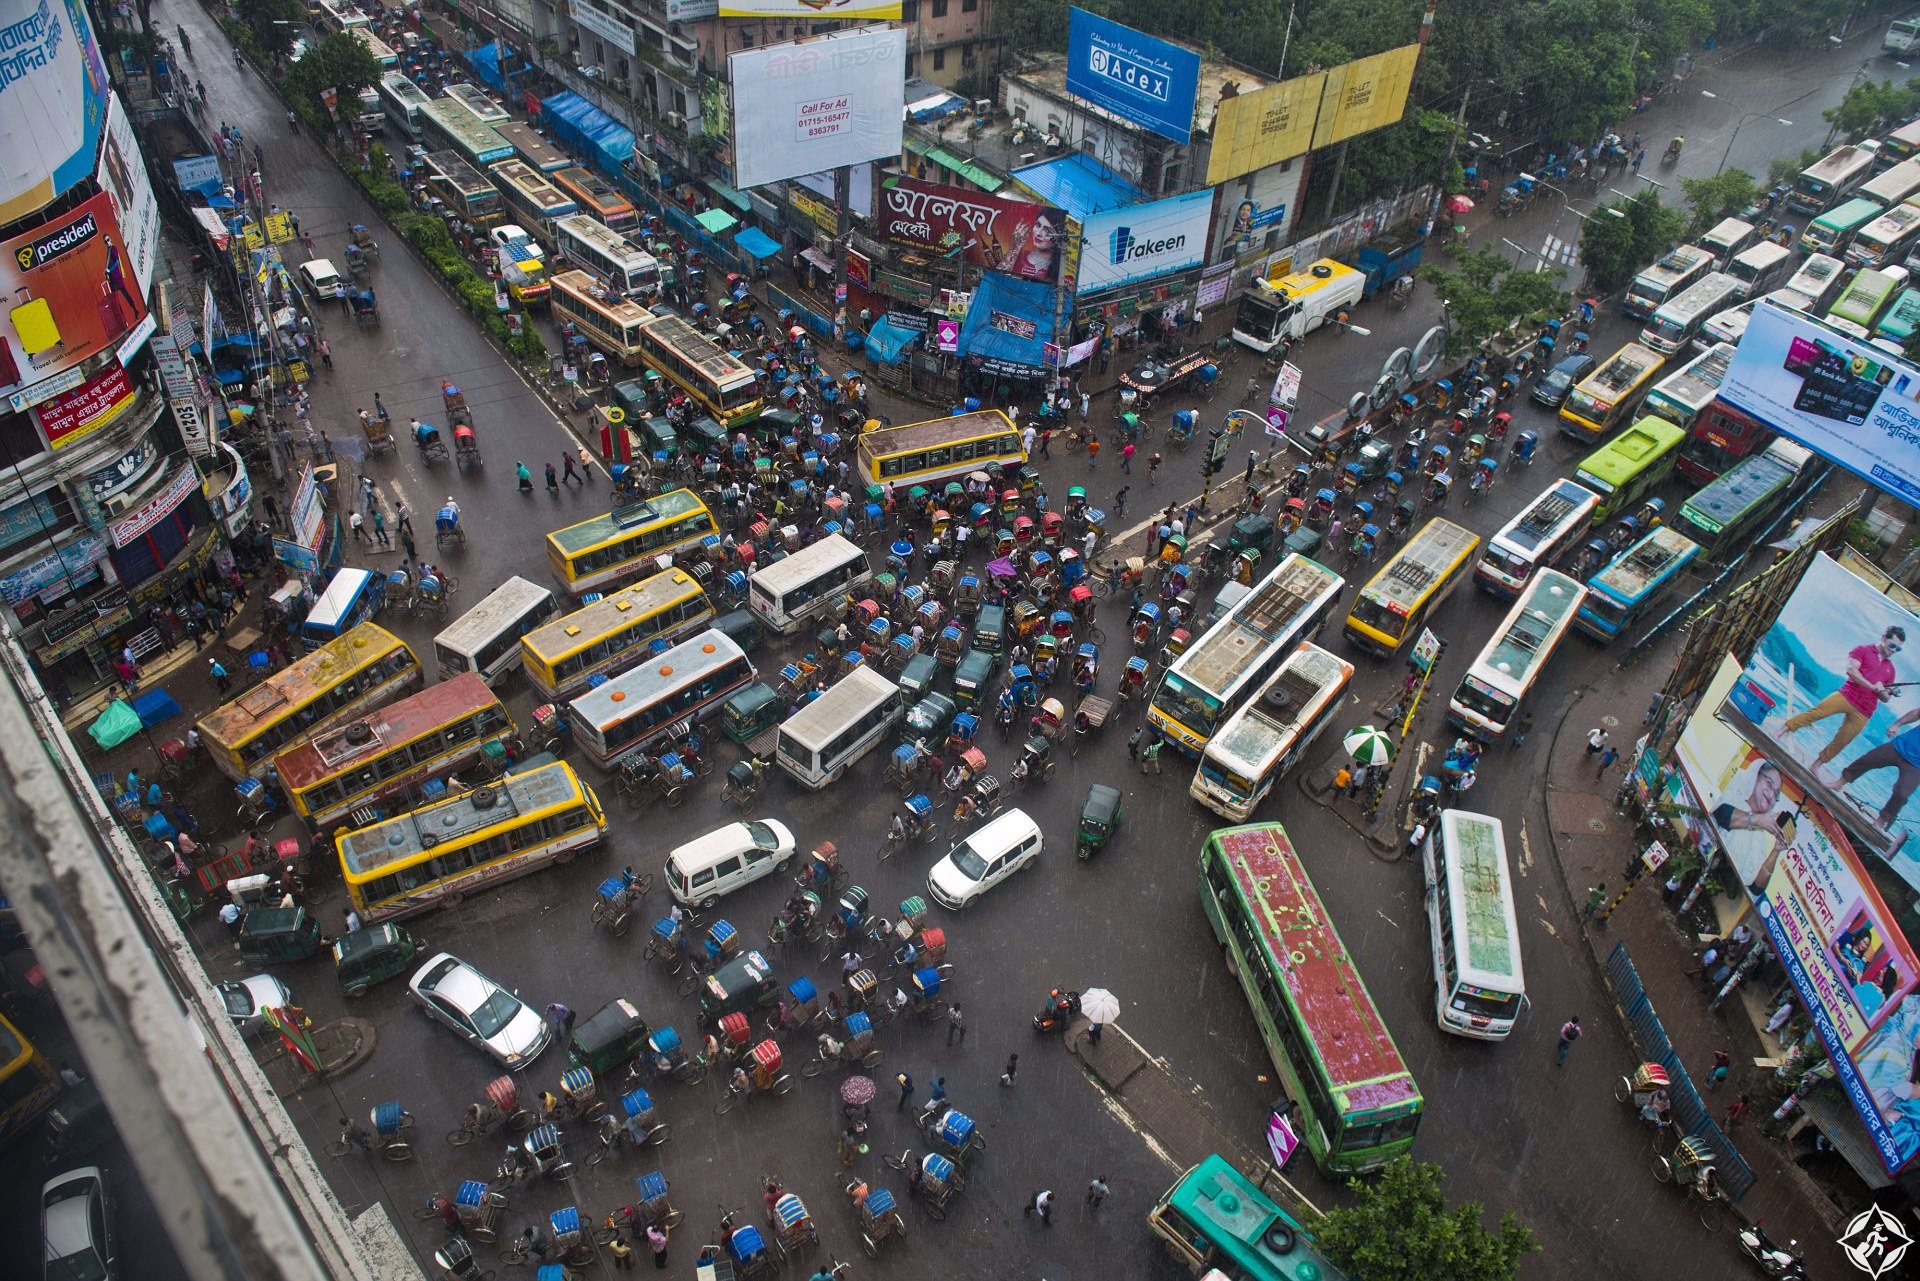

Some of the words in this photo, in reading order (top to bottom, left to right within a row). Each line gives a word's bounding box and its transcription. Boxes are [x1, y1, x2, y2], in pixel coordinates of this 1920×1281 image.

[1111, 60, 1163, 95] Adex
[798, 112, 850, 128] 01715-165477
[801, 104, 818, 114] Call
[819, 102, 834, 112] For
[835, 99, 848, 108] Ad
[808, 124, 840, 136] 8363791
[886, 188, 1002, 235] আলফা
[37, 218, 95, 262] president
[1127, 235, 1186, 262] rakeen
[32, 359, 52, 372] Travel
[50, 416, 75, 430] মামুন
[1786, 847, 1812, 879] শেখ
[1803, 878, 1836, 927] হাসিনা
[1807, 960, 1855, 1043] অভিনন্দন
[1766, 914, 1795, 964] বাংলাদেশ
[1790, 964, 1820, 1009] আওয়ামী
[1814, 1009, 1841, 1051] যুবলীগ
[1834, 1051, 1855, 1079] ঢাকা
[1850, 1079, 1882, 1131] মহানগর
[1877, 1131, 1901, 1168] দক্ষিণ
